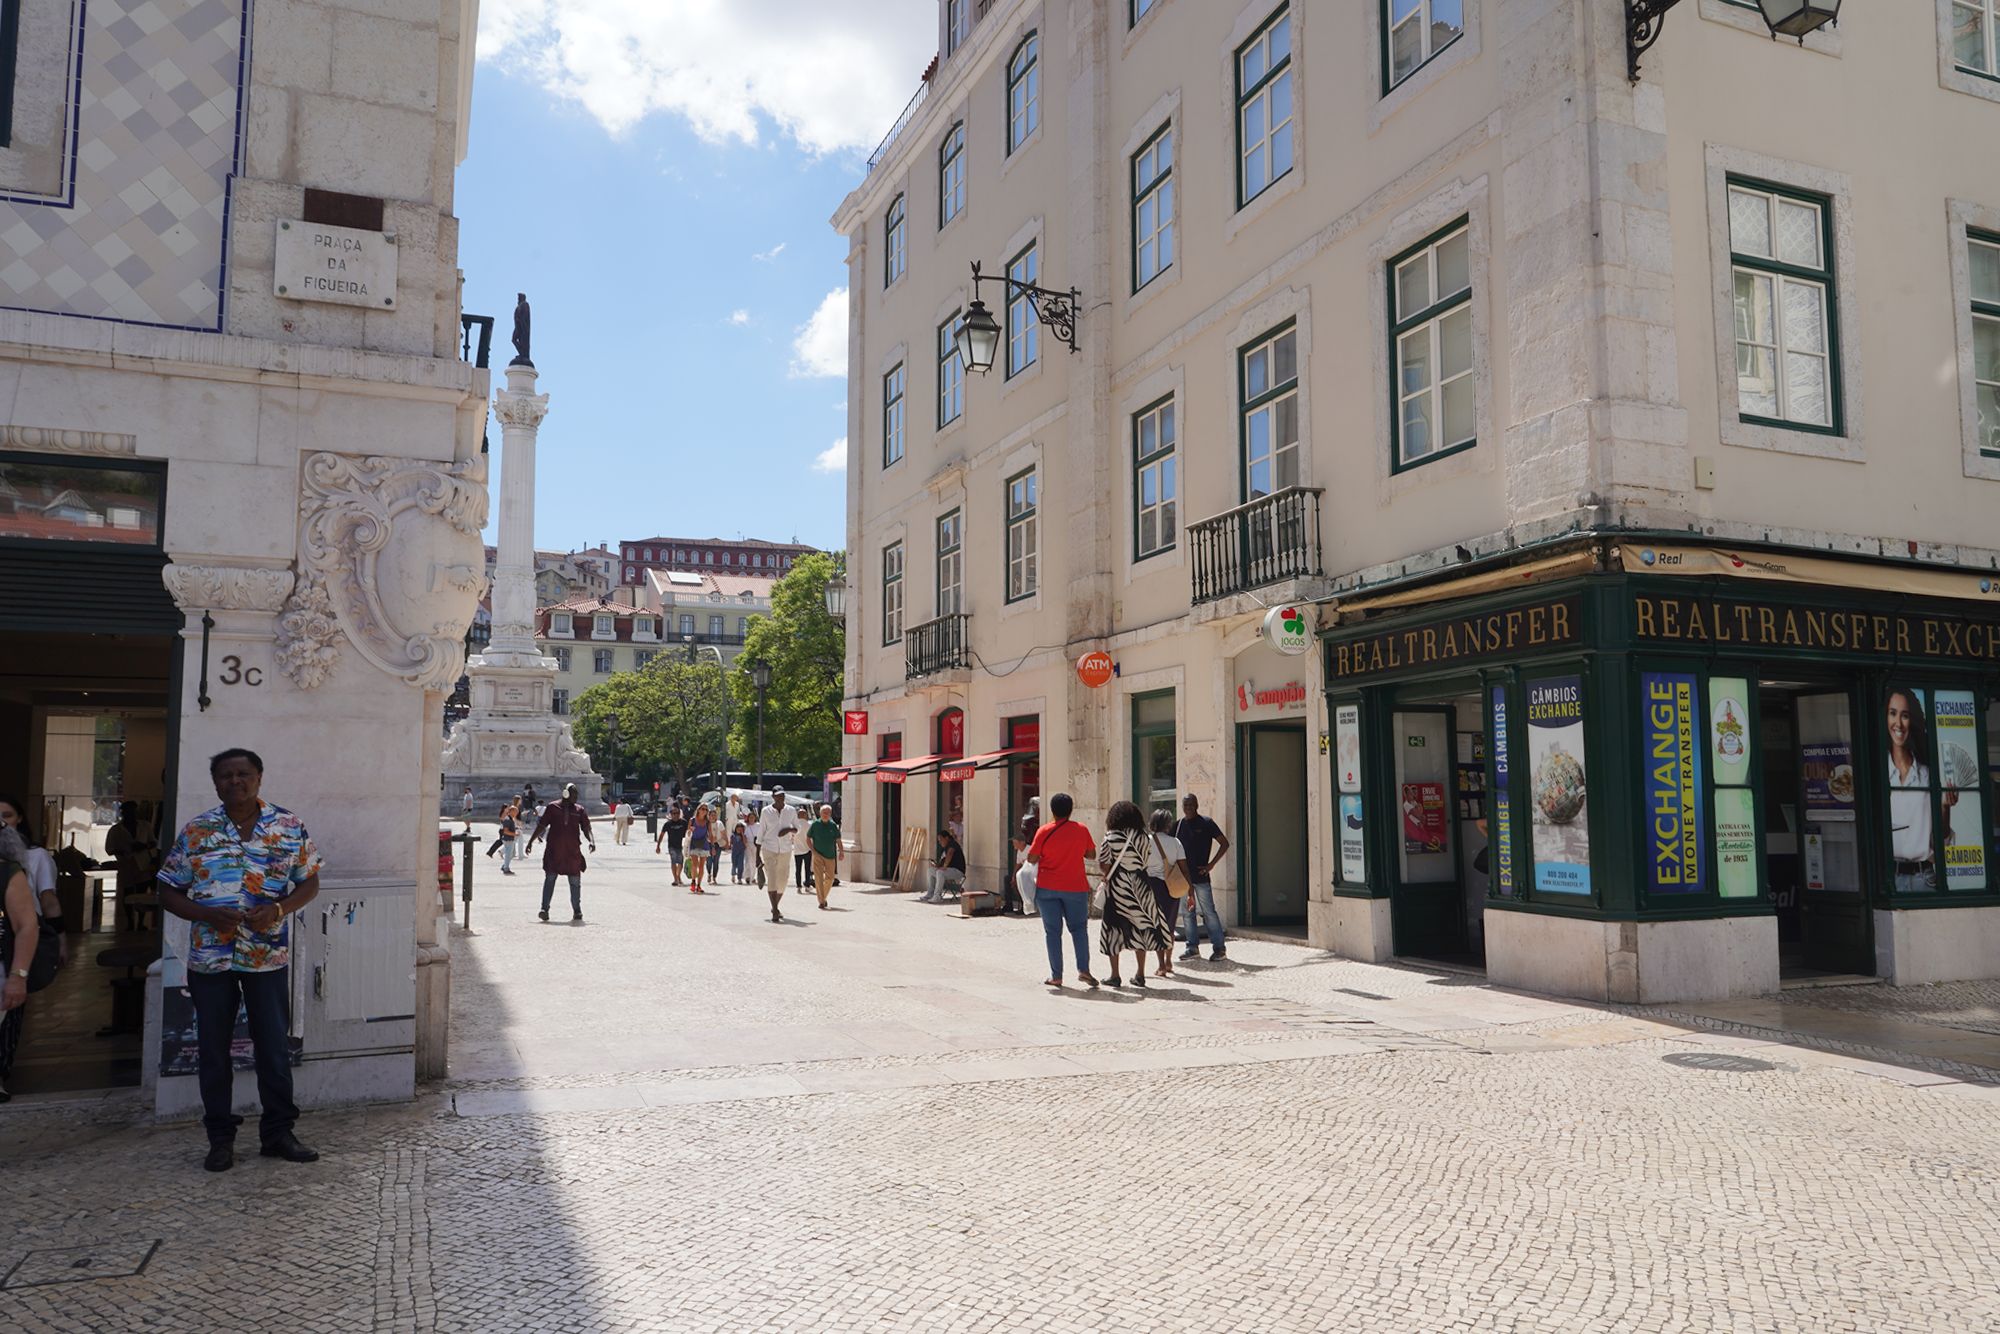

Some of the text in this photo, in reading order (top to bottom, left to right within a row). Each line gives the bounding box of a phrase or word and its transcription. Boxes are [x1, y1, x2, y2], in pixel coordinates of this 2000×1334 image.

[314, 234, 362, 252] PRAÇA
[327, 257, 347, 271] DA
[304, 276, 368, 295] FIGUEIRA
[1658, 553, 1682, 565] Real
[1281, 637, 1305, 647] JOGOS
[1085, 659, 1110, 670] ATM
[1531, 686, 1577, 704] CÂMBIOS
[1529, 701, 1581, 719] EXCHANGE
[1936, 701, 1974, 715] EXCHANGE
[1494, 703, 1509, 773] CÂMBIOS
[1650, 681, 1681, 884] EXCHANGE
[1679, 690, 1697, 879] MONEY TRANSFER
[1497, 800, 1512, 887] EXCHANGE
[1724, 854, 1731, 862] de
[1945, 846, 1982, 864] CÂMBIOS
